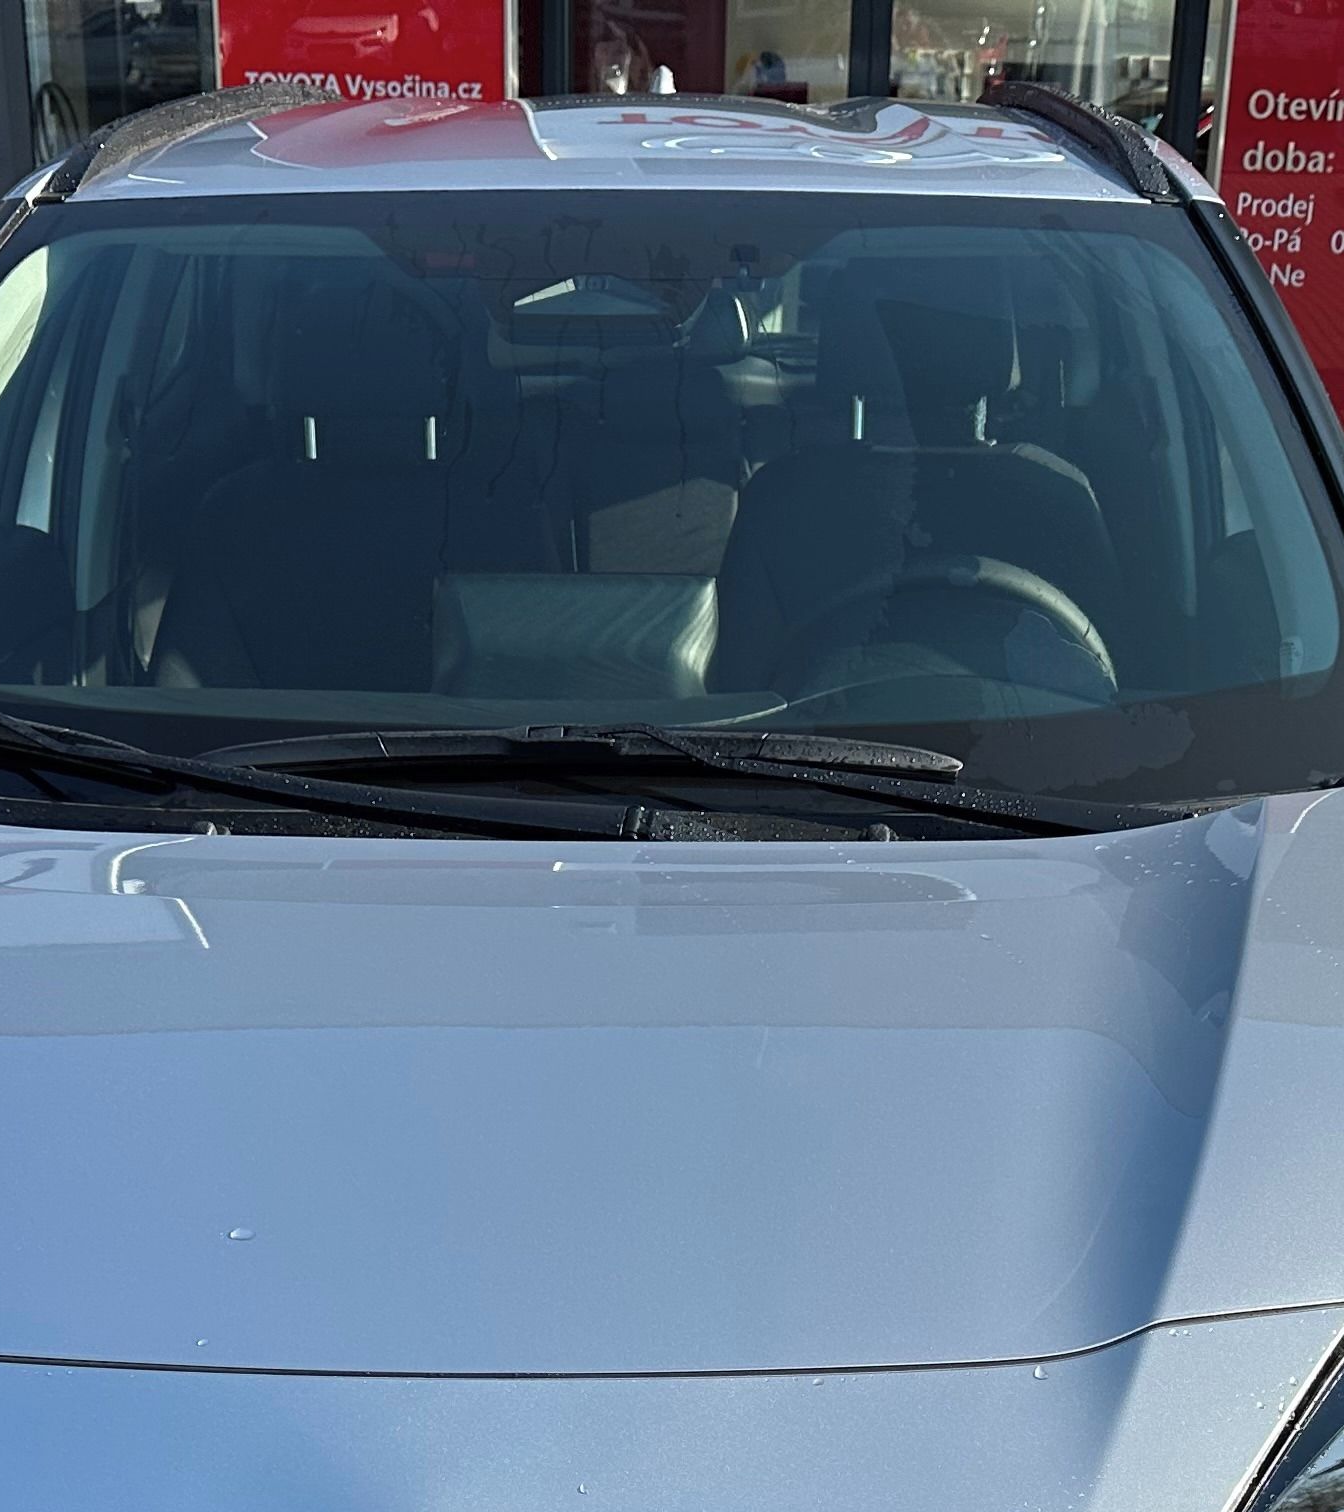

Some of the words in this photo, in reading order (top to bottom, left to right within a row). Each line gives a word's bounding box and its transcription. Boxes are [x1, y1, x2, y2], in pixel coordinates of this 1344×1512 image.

[345, 73, 482, 99] Vysočina.cz
[1242, 140, 1335, 173] doba:
[1236, 192, 1315, 225] Prodej
